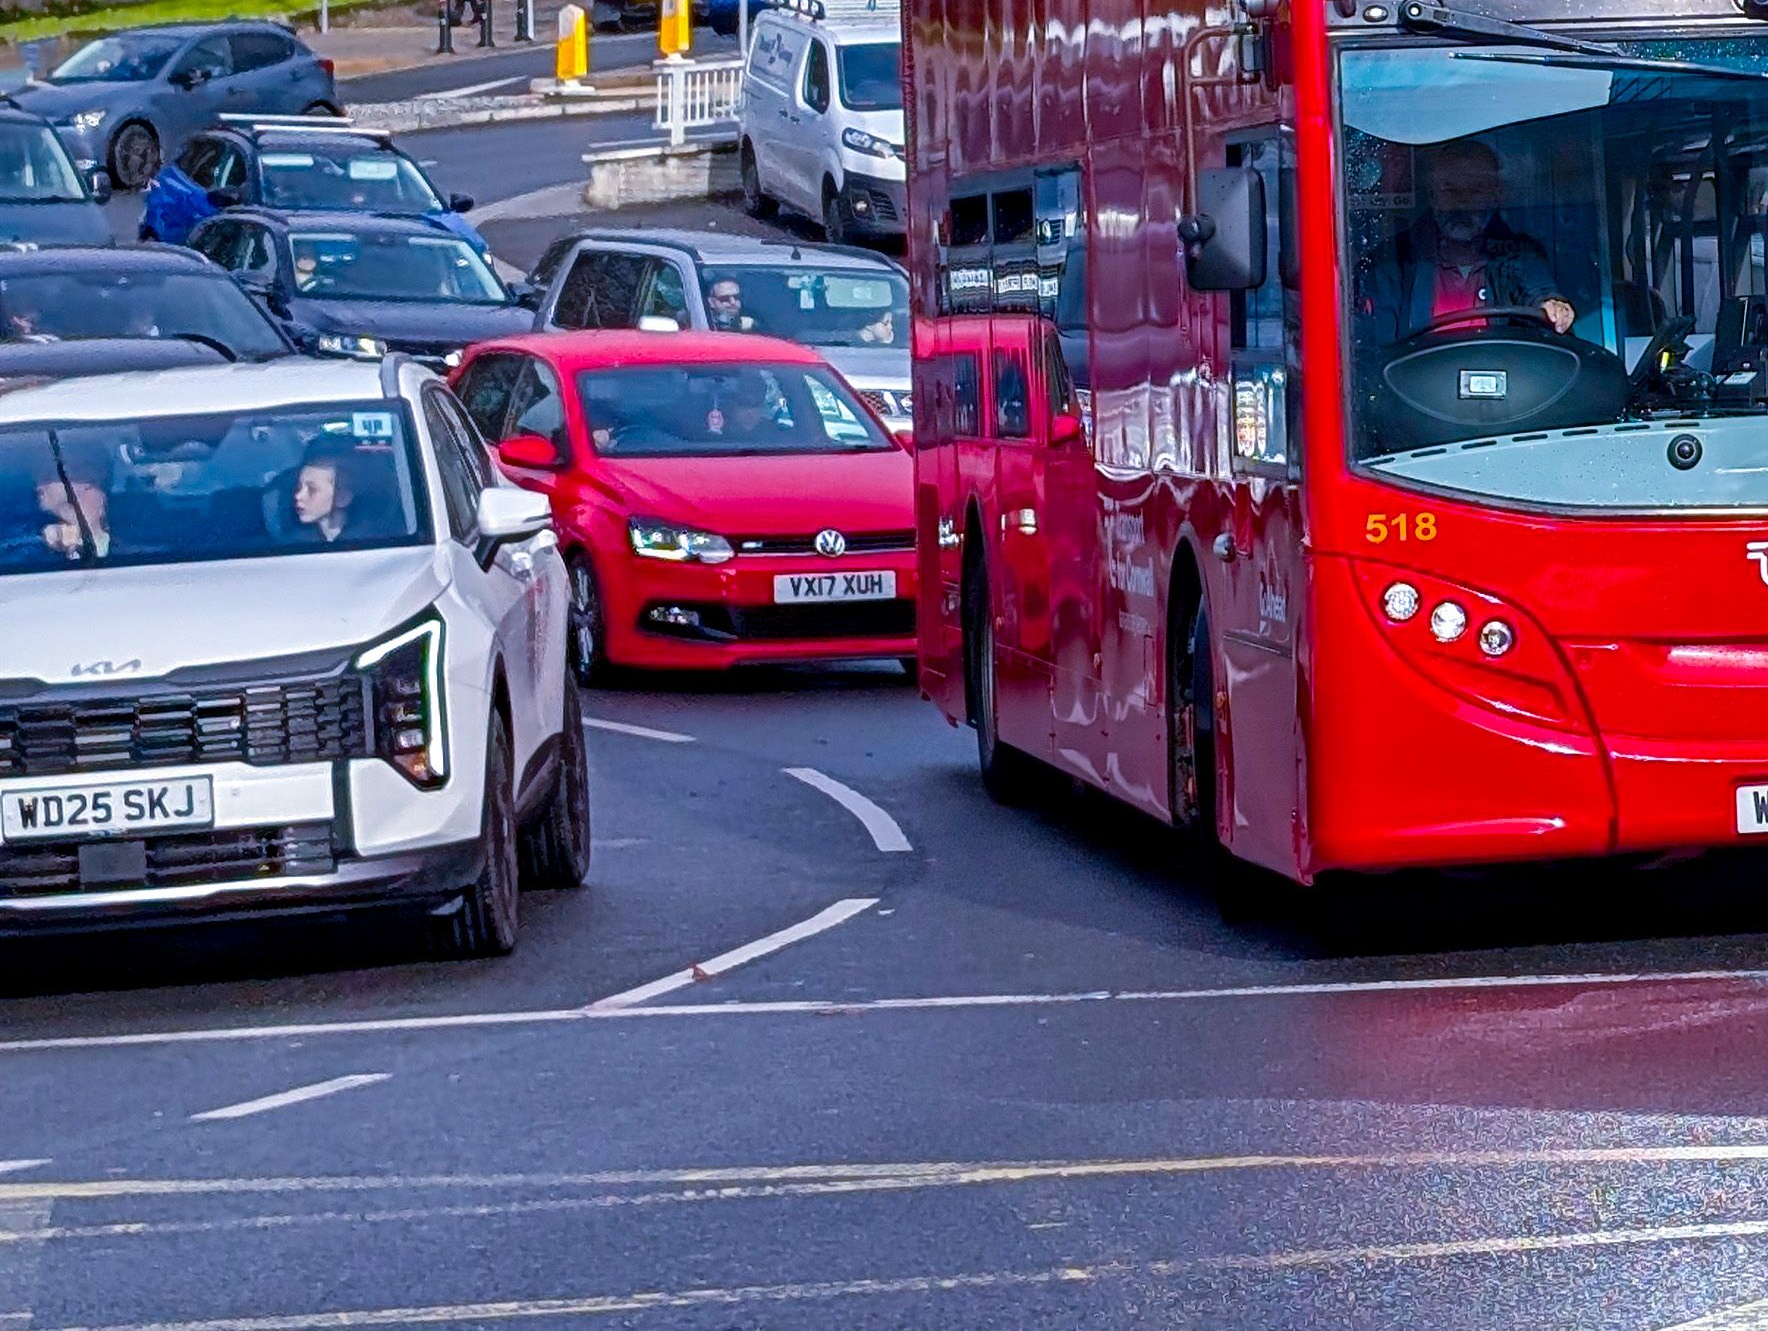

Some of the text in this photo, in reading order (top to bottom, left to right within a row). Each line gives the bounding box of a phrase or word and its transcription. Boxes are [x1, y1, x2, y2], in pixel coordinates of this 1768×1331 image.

[1365, 512, 1437, 544] 518
[790, 574, 883, 597] VX17 XUH
[18, 784, 194, 829] WD25 SKJ
